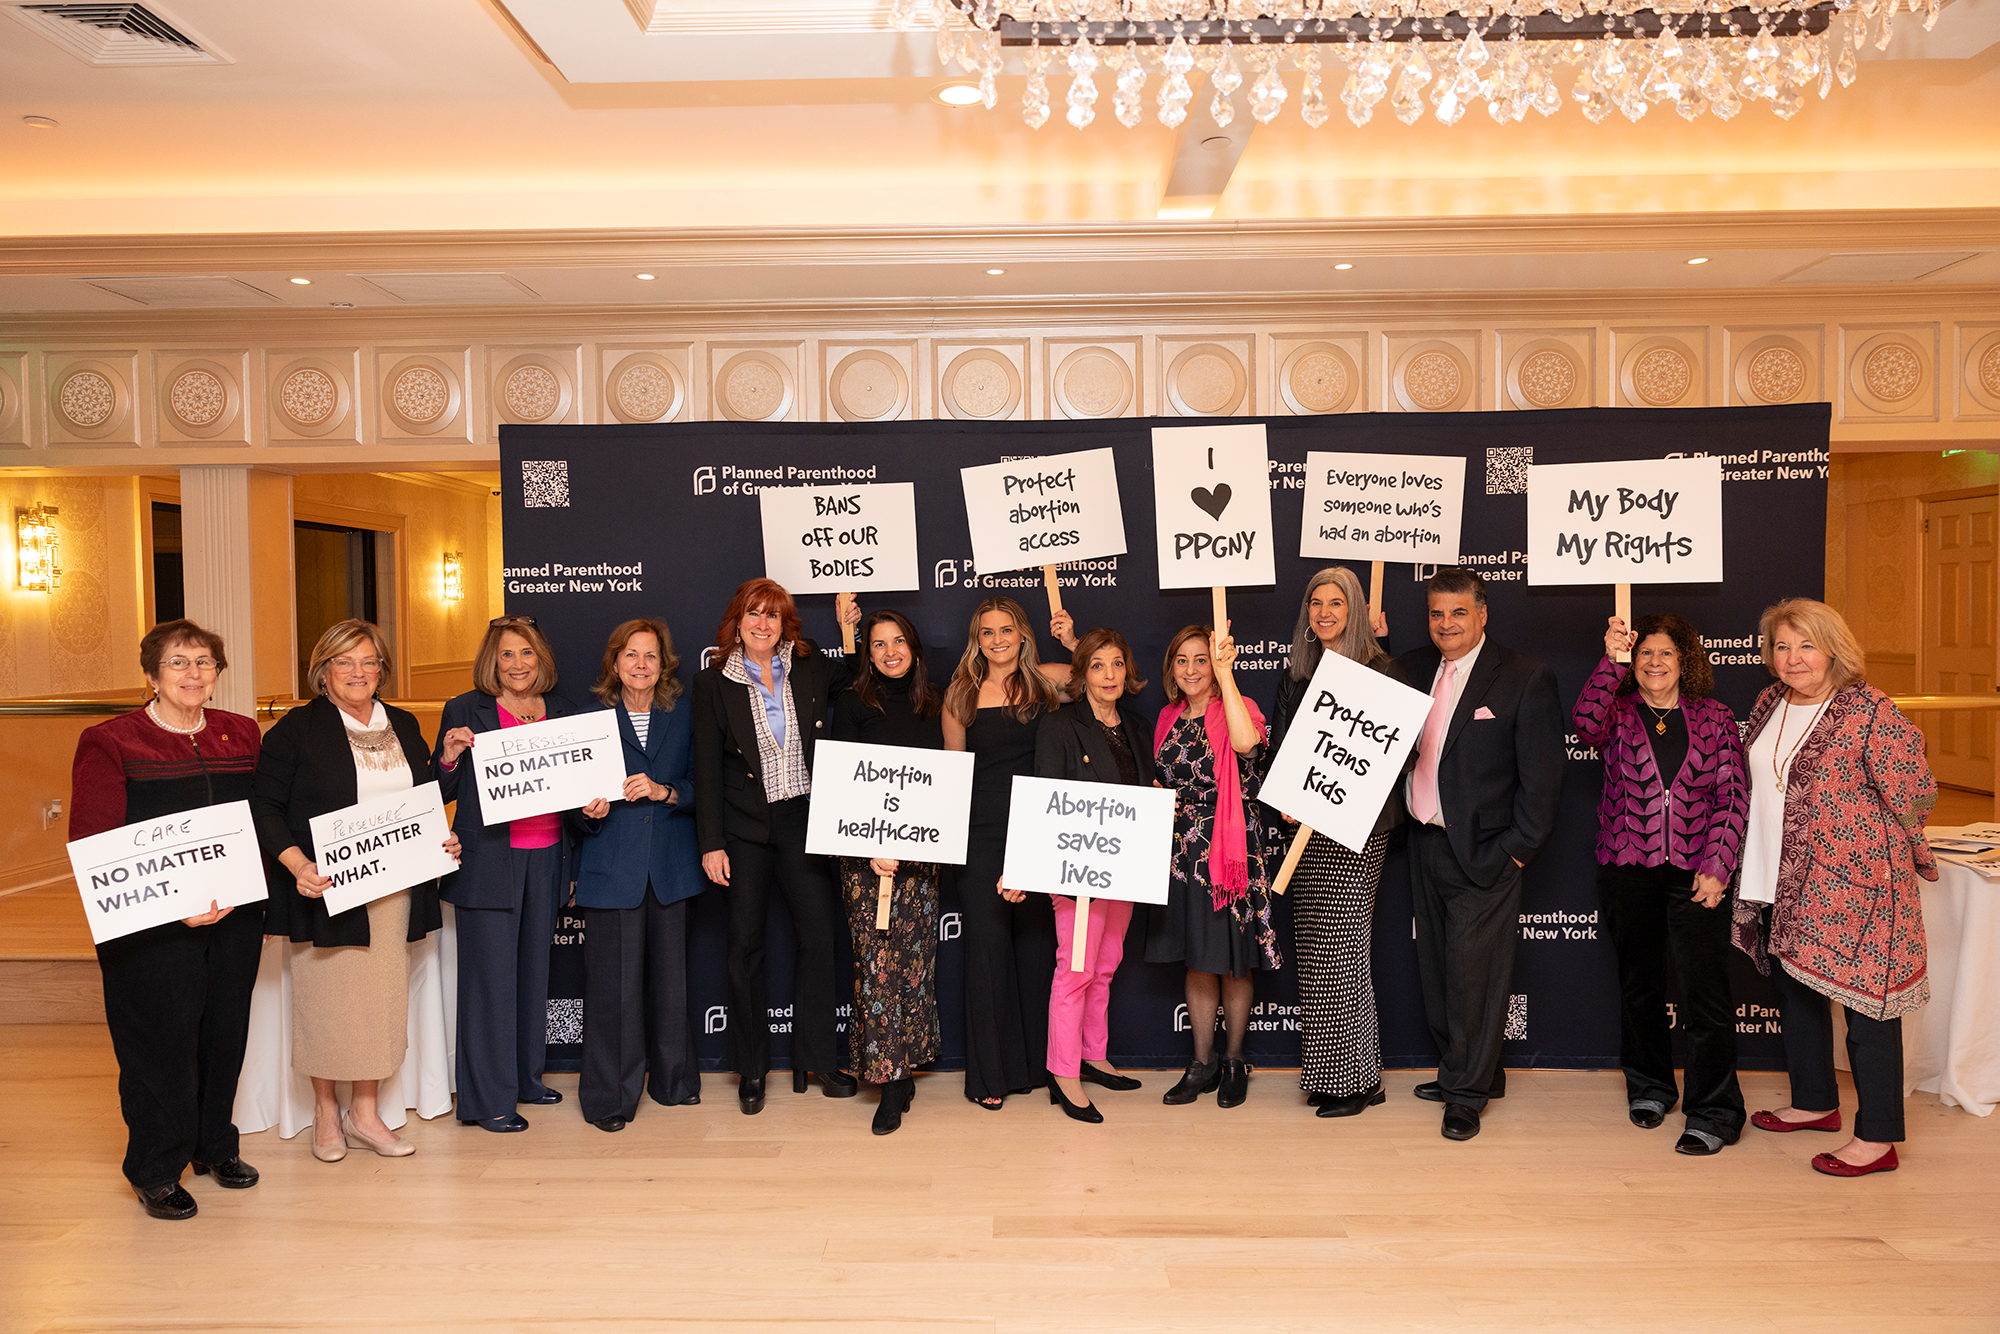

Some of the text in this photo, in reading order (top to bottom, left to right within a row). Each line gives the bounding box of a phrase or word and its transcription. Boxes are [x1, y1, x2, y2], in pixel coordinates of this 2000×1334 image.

[1207, 446, 1214, 470] I
[1693, 447, 1829, 464] nned Parentho
[722, 465, 877, 479] Planned Parenthood
[1003, 468, 1076, 496] Protect
[1283, 476, 1306, 489] Ne
[1326, 469, 1443, 491] Everyone loves
[1776, 465, 1814, 480] New
[722, 481, 739, 495] of
[813, 494, 861, 516] BANS
[1009, 499, 1081, 524] abortion
[1323, 499, 1442, 518] someone who's
[1568, 487, 1679, 522] My Body
[801, 526, 879, 547] OFF OUR
[1019, 530, 1080, 552] access
[1173, 530, 1256, 560] PPGNY
[1319, 525, 1441, 549] had an abortion
[1459, 550, 1508, 565] anned
[1556, 531, 1693, 566] My Rights
[503, 562, 643, 577] anned Parenthood
[808, 556, 874, 579] BODIES
[1466, 568, 1523, 581] reater
[508, 580, 566, 594] Greater
[569, 579, 604, 593] New
[606, 578, 643, 592] York
[963, 573, 1118, 588] of Greater ew York
[1697, 634, 1753, 649] lanned
[1233, 658, 1280, 670] reater
[1313, 690, 1400, 755] Protect
[501, 731, 578, 757] PERSIST
[1313, 730, 1371, 776] Trans
[1565, 746, 1600, 760] York
[485, 747, 594, 780] NO MATTER
[853, 760, 932, 791] Abortion
[1302, 765, 1347, 805] Kids
[488, 778, 551, 801] WHAT.
[883, 792, 900, 812] is
[1046, 790, 1136, 826] Abortion
[332, 802, 406, 839] PERSEVERE
[837, 816, 940, 845] healthcare
[133, 818, 192, 847] CARE
[325, 822, 422, 866] NO MATTER
[1057, 831, 1122, 855] saves
[91, 843, 227, 890] NO MATTER
[329, 859, 387, 888] WHAT.
[1060, 860, 1112, 889] lives
[96, 880, 179, 914] WHAT.
[1518, 910, 1599, 924] arenthood
[1522, 926, 1598, 940] New York
[1282, 1018, 1303, 1032] Ne
